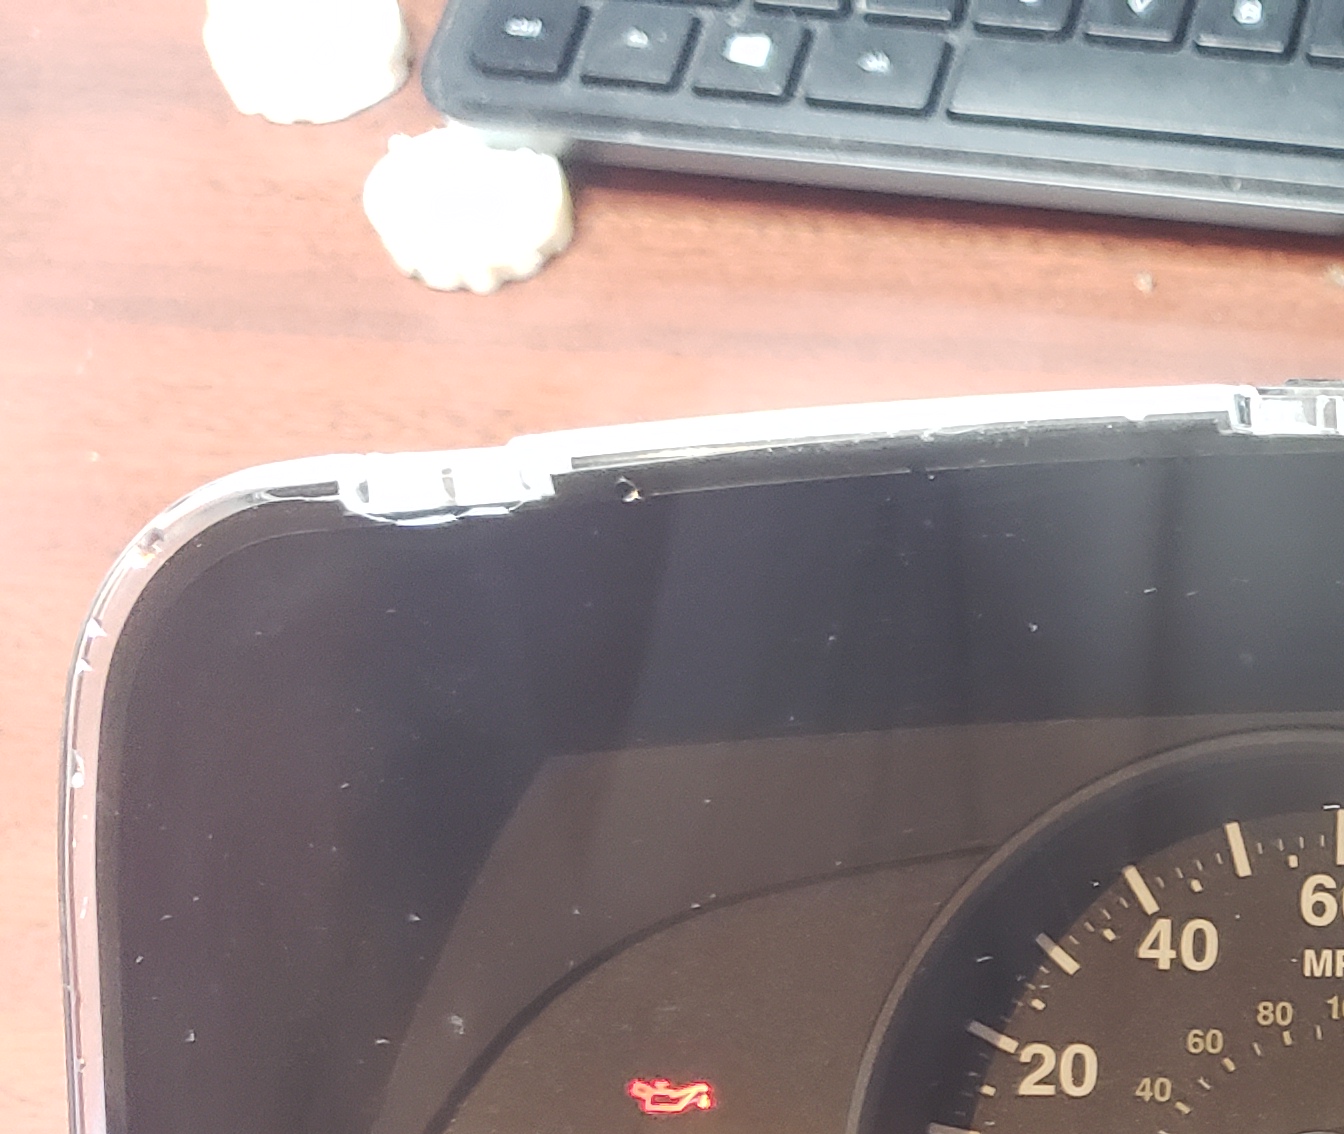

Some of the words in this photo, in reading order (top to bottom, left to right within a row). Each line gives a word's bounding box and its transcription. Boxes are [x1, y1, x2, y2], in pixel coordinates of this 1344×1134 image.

[1137, 917, 1220, 972] 40
[1256, 1001, 1294, 1027] 80
[1186, 1028, 1225, 1055] 60
[1018, 1043, 1098, 1098] 20
[1134, 1076, 1173, 1103] 40
